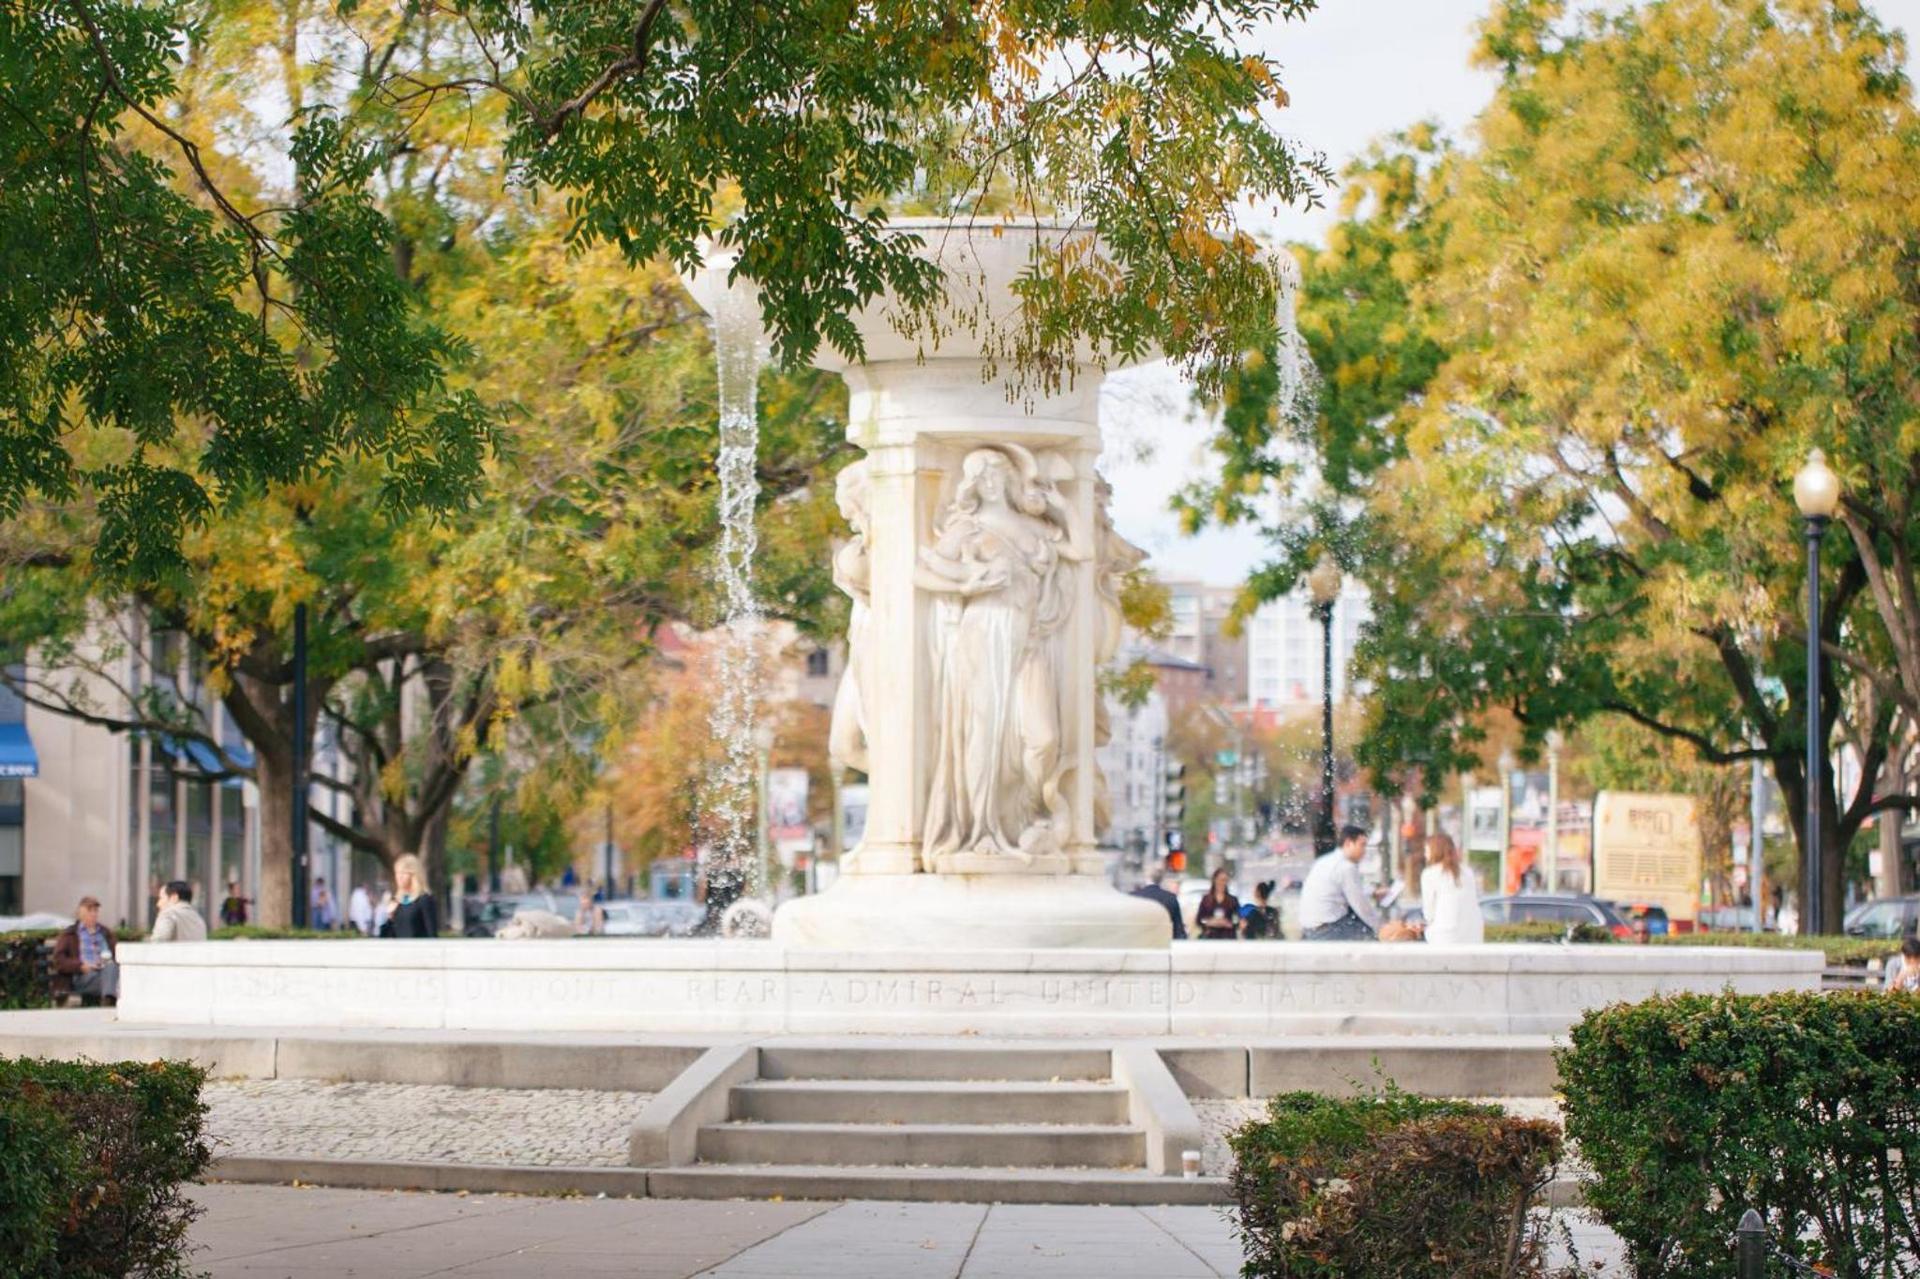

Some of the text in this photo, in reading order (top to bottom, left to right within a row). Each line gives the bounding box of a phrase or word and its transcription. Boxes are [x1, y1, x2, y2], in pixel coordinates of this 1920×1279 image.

[686, 979, 777, 1003] REAR
[817, 980, 1005, 1004] ADMIRAL
[1041, 980, 1196, 1004] UNITED
[1231, 980, 1367, 1004] STATES
[1400, 980, 1489, 1004] NAVY
